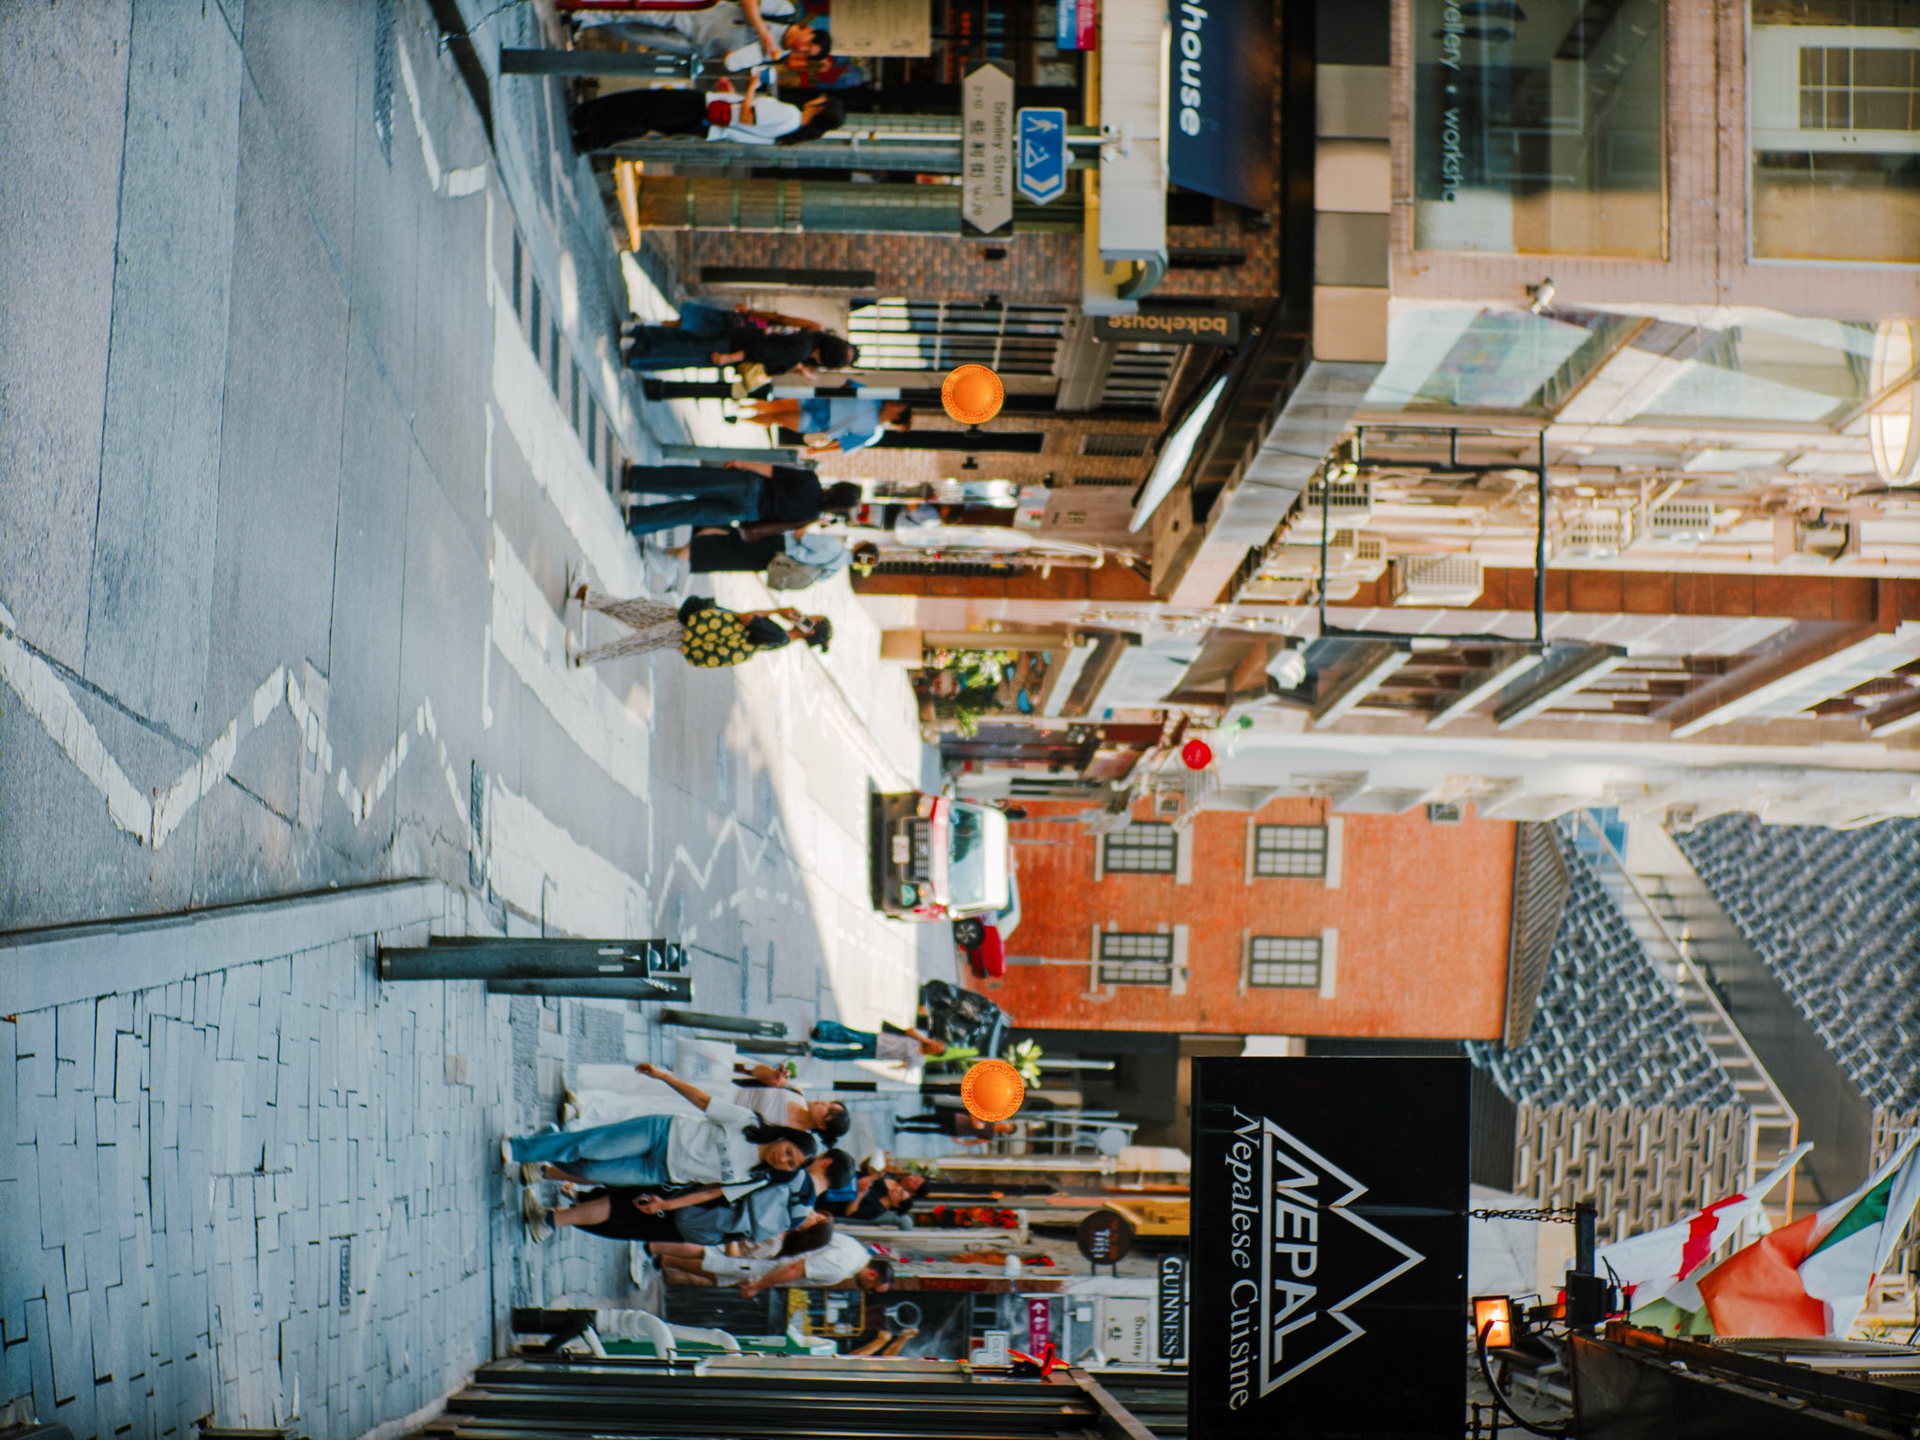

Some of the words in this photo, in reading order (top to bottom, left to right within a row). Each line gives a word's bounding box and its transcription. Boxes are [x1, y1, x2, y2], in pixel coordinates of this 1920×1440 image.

[1180, 0, 1209, 136] house
[992, 101, 1008, 149] Shelley
[993, 155, 1008, 197] Street
[1108, 315, 1227, 336] bakehouse
[1224, 1106, 1260, 1269] Nepalese
[1162, 1256, 1182, 1356] GUINNESS
[1274, 1150, 1318, 1364] NEPAL
[1132, 1316, 1146, 1358] Shelley
[1230, 1278, 1259, 1411] Cuisine
